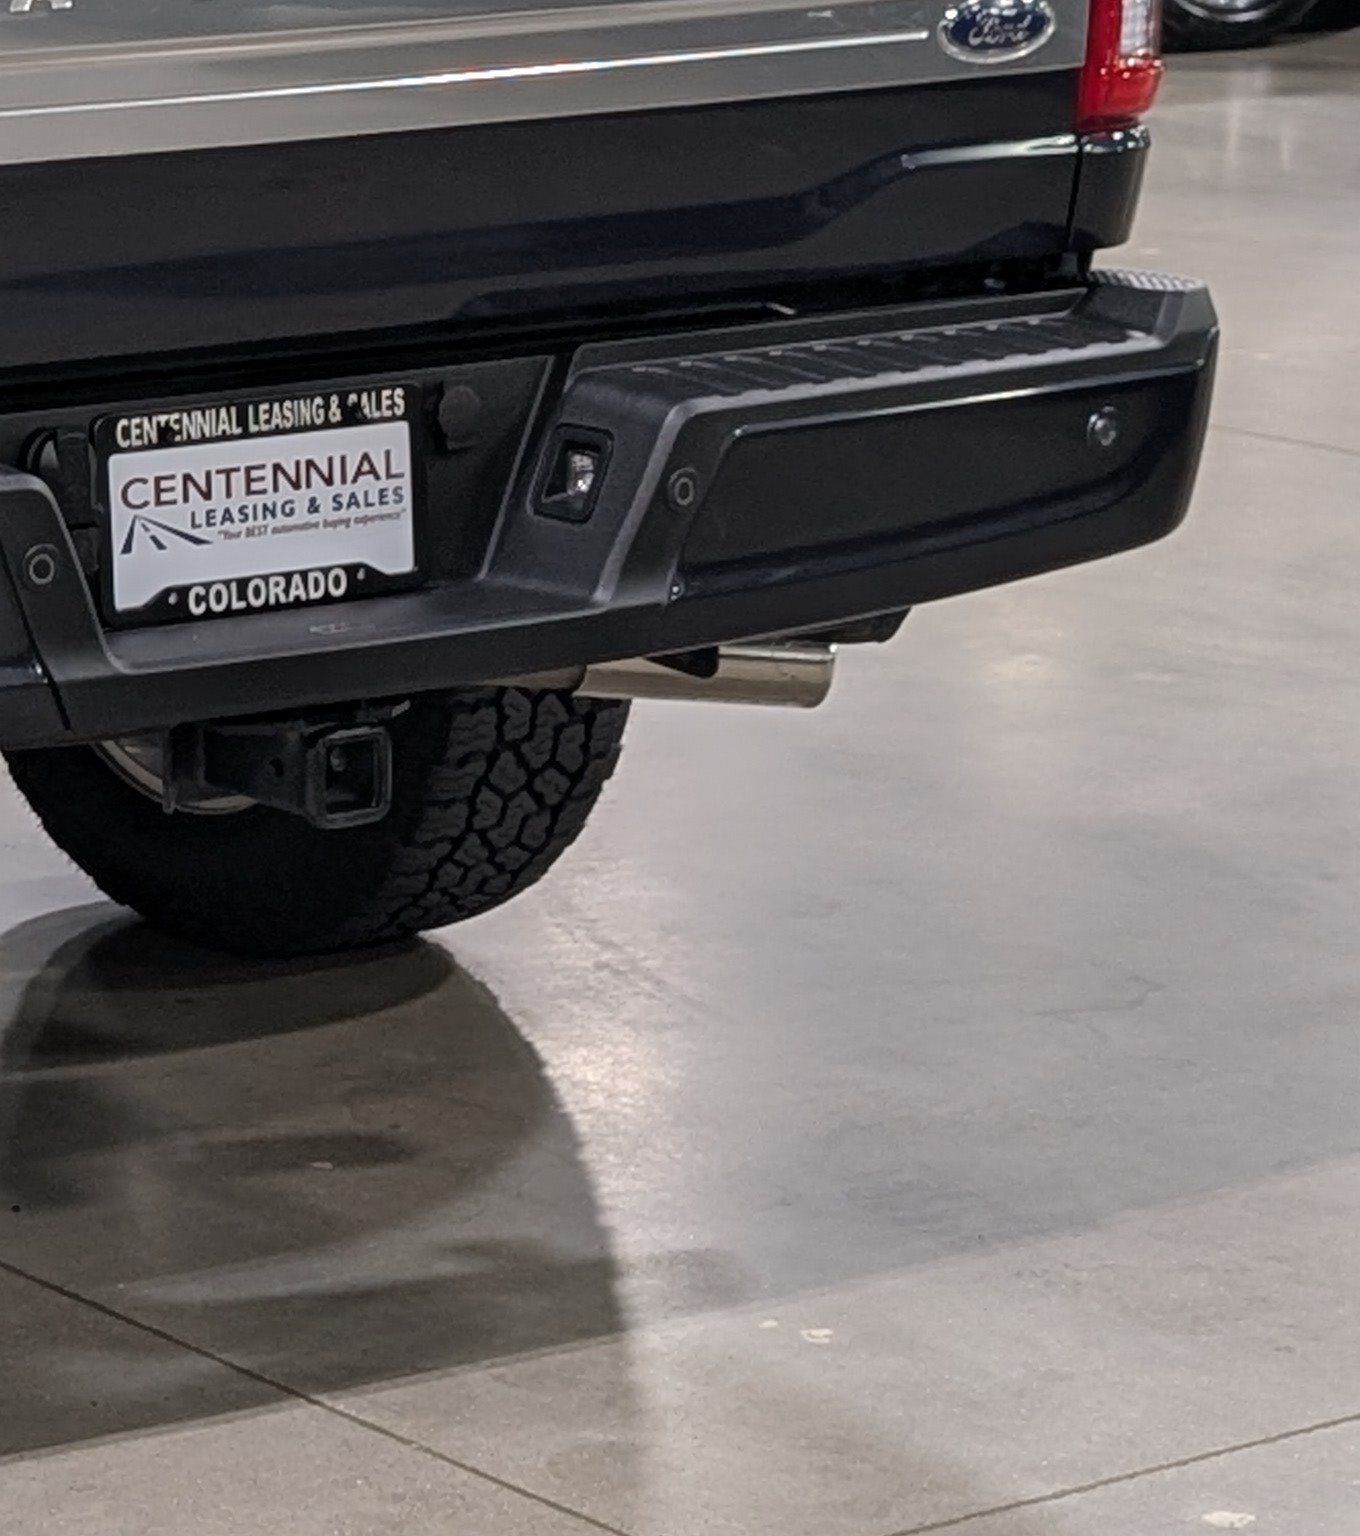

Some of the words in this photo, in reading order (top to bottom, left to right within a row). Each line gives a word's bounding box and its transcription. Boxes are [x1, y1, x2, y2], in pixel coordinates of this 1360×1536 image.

[248, 395, 324, 433] LEASING
[329, 394, 342, 424] &
[120, 449, 405, 510] CENTENNIAL
[190, 499, 296, 530] LEASING
[307, 496, 321, 515] &
[332, 486, 405, 512] SALES
[188, 568, 348, 615] COLORADO
